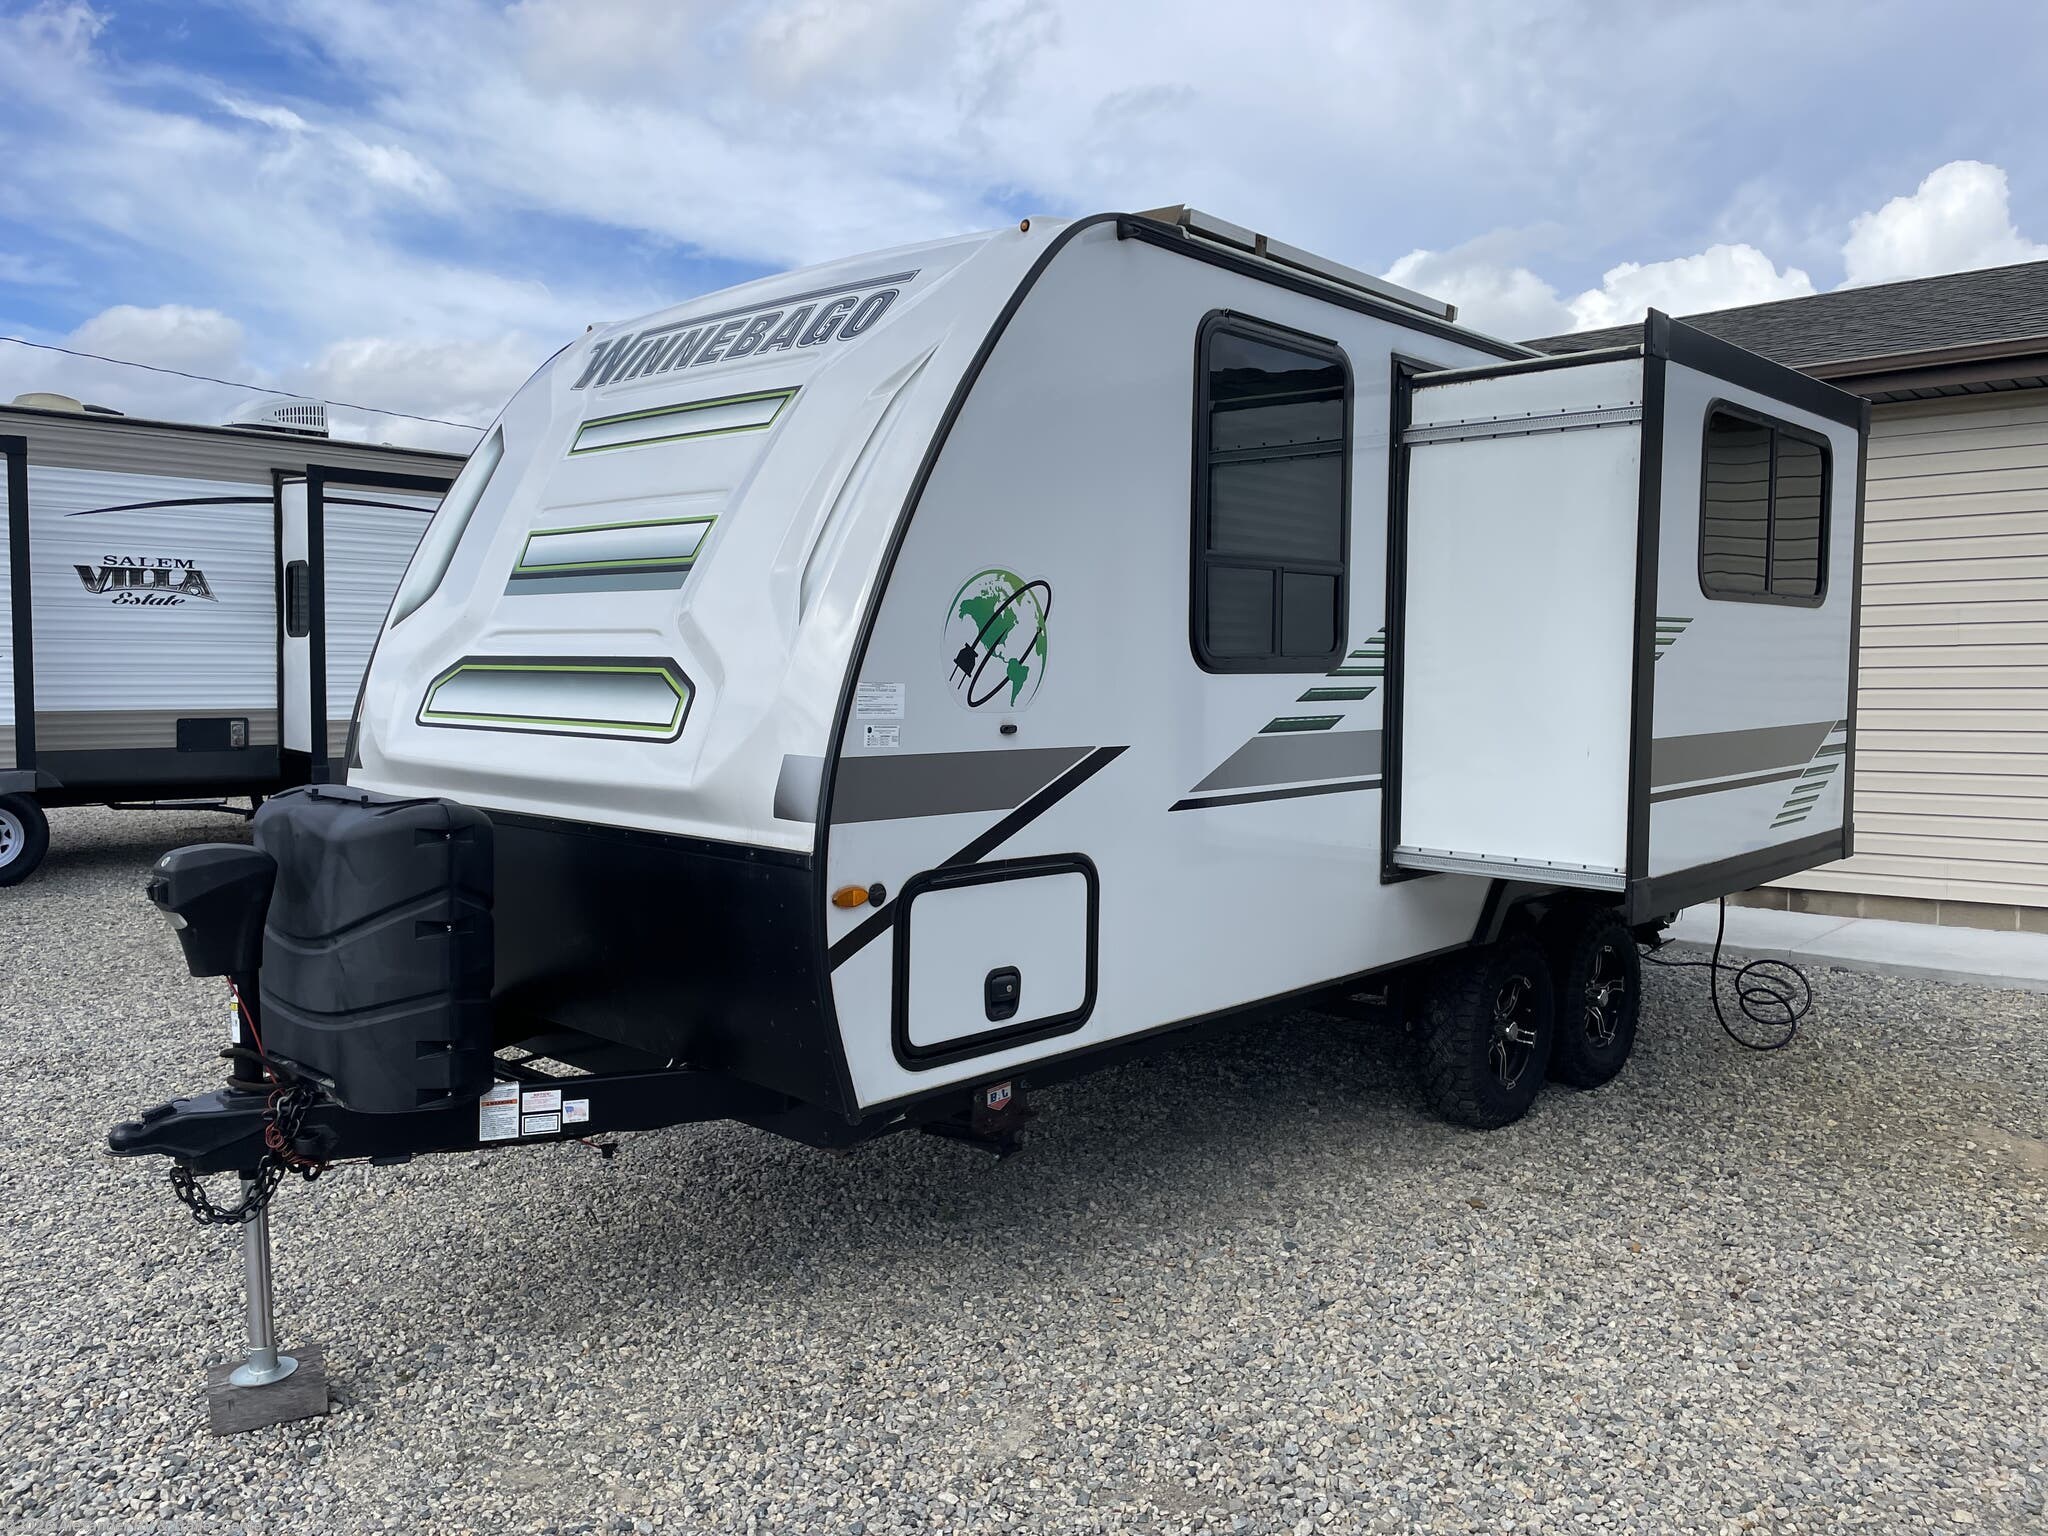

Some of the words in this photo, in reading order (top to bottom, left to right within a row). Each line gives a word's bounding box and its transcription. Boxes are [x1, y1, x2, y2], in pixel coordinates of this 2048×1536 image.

[570, 288, 900, 391] WINNEBAGO
[103, 555, 195, 569] SALEM
[73, 564, 219, 602] VILLA
[111, 592, 186, 606] Estate
